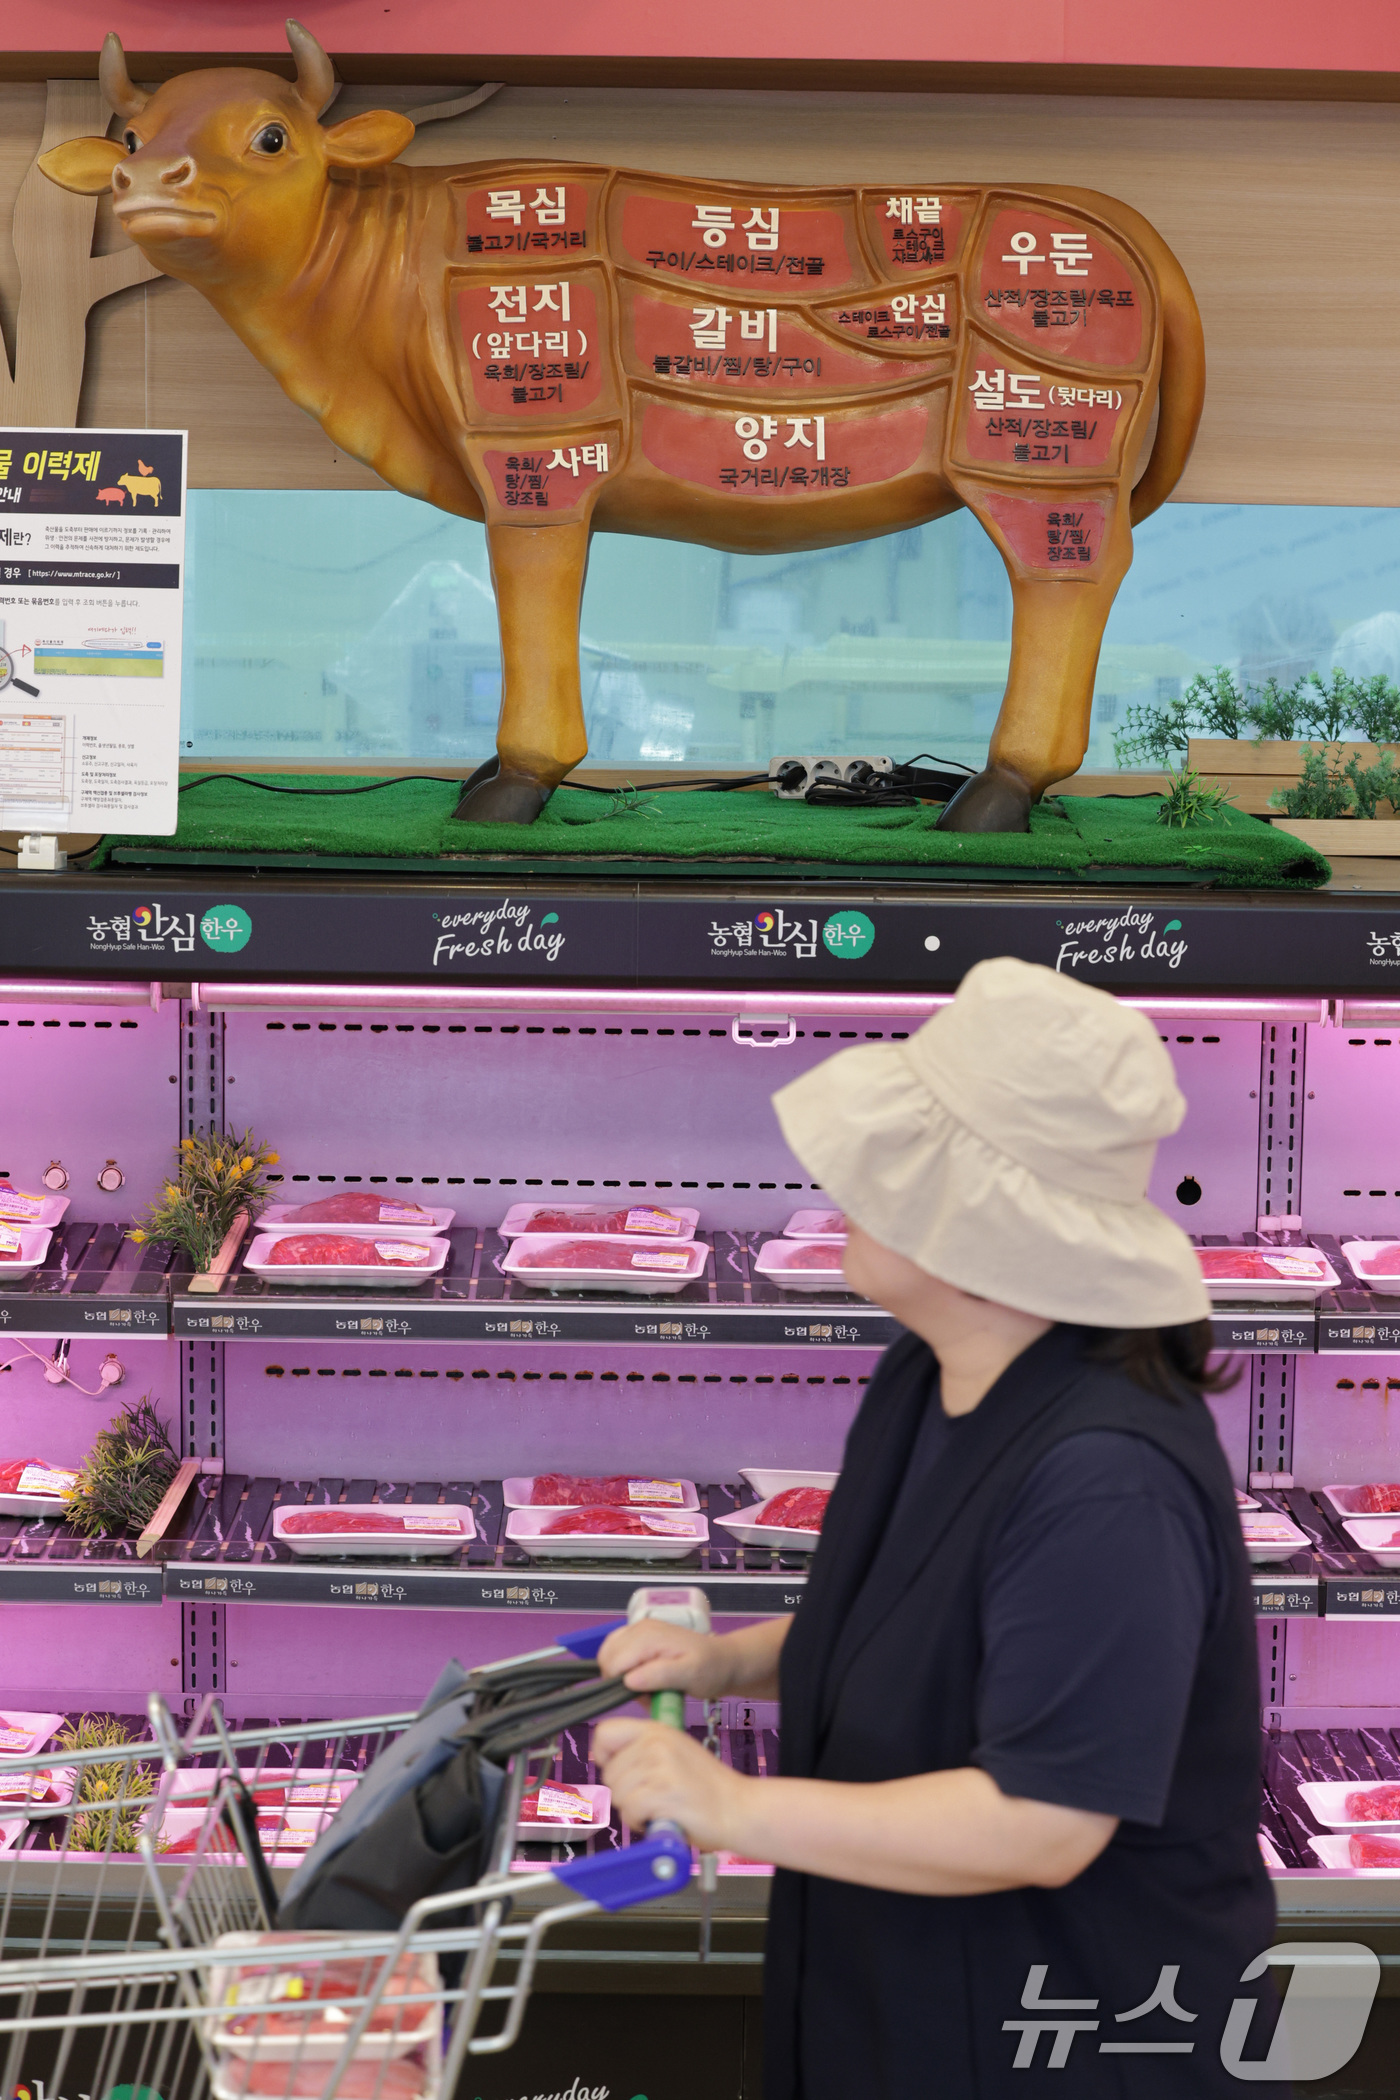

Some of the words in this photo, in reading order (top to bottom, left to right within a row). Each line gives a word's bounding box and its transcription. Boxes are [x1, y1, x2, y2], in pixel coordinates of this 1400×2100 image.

[486, 186, 567, 226] 목심
[885, 197, 943, 225] 채끝
[691, 205, 780, 251] 등심
[466, 230, 587, 253] 불고기/국거리
[646, 250, 825, 276] 구이/스테이크/전골
[1001, 231, 1093, 276] 우둔
[487, 281, 571, 324] 전지
[890, 293, 946, 324] 안심
[984, 288, 1135, 308] 산적/장조림/육포
[838, 311, 891, 324] 스테이크
[1031, 309, 1088, 328] 불고기
[688, 306, 779, 354] 갈비
[867, 324, 951, 340] 로스구이/전골
[472, 329, 588, 360] (앞다리)
[484, 361, 590, 382] 육회/장조림/
[652, 354, 822, 377] 불갈비/찜/탕/구이
[510, 383, 563, 404] 불고기
[968, 369, 1046, 411] 설도
[1048, 385, 1123, 411] (뒷다리)
[734, 415, 826, 462] 양지
[985, 417, 1098, 440] 산적/장조림/
[546, 443, 609, 477] 사태
[1012, 443, 1070, 464] 불고기
[23, 449, 101, 482] 이력제
[718, 465, 851, 488] 국거리/육개장
[504, 491, 549, 507] 장조림
[1047, 546, 1091, 562] 장조림
[4, 567, 22, 579] 경우
[441, 898, 531, 935] everyday
[1065, 905, 1155, 942] everyday
[86, 915, 131, 942] 농협
[200, 917, 243, 941] 한우
[707, 921, 753, 947] 농협
[823, 923, 866, 947] 한우
[90, 943, 122, 952] NongHyup
[122, 943, 136, 951] Safe
[136, 943, 165, 951] Han-Woo
[433, 926, 513, 966] Fresh
[517, 923, 566, 962] day
[710, 949, 743, 958] NongHyup
[758, 949, 787, 957] Han-Woo
[1056, 933, 1135, 973] Fresh
[1140, 930, 1188, 969] day
[84, 1311, 107, 1321] 농협
[133, 1309, 160, 1326] 한우
[186, 1317, 210, 1328] 농협
[236, 1316, 263, 1333] 한우
[335, 1319, 358, 1330] 농협
[385, 1318, 412, 1336] 한우
[485, 1322, 508, 1332] 농협
[534, 1320, 562, 1338] 한우
[635, 1324, 658, 1334] 농협
[684, 1323, 711, 1340] 한우
[784, 1326, 807, 1336] 농협
[834, 1324, 861, 1342] 한우
[1232, 1331, 1255, 1341] 농협
[1281, 1329, 1307, 1346] 한우
[1328, 1328, 1351, 1339] 농협
[73, 1582, 97, 1593] 농협
[123, 1580, 151, 1598] 한우
[180, 1579, 203, 1589] 농협
[229, 1577, 257, 1595] 한우
[330, 1583, 353, 1595] 농협
[380, 1583, 407, 1601] 한우
[481, 1588, 504, 1599] 농협
[531, 1587, 559, 1605] 한우
[1286, 1593, 1314, 1610] 한우
[1336, 1591, 1360, 1602] 농협
[1386, 1590, 1400, 1605] 한
